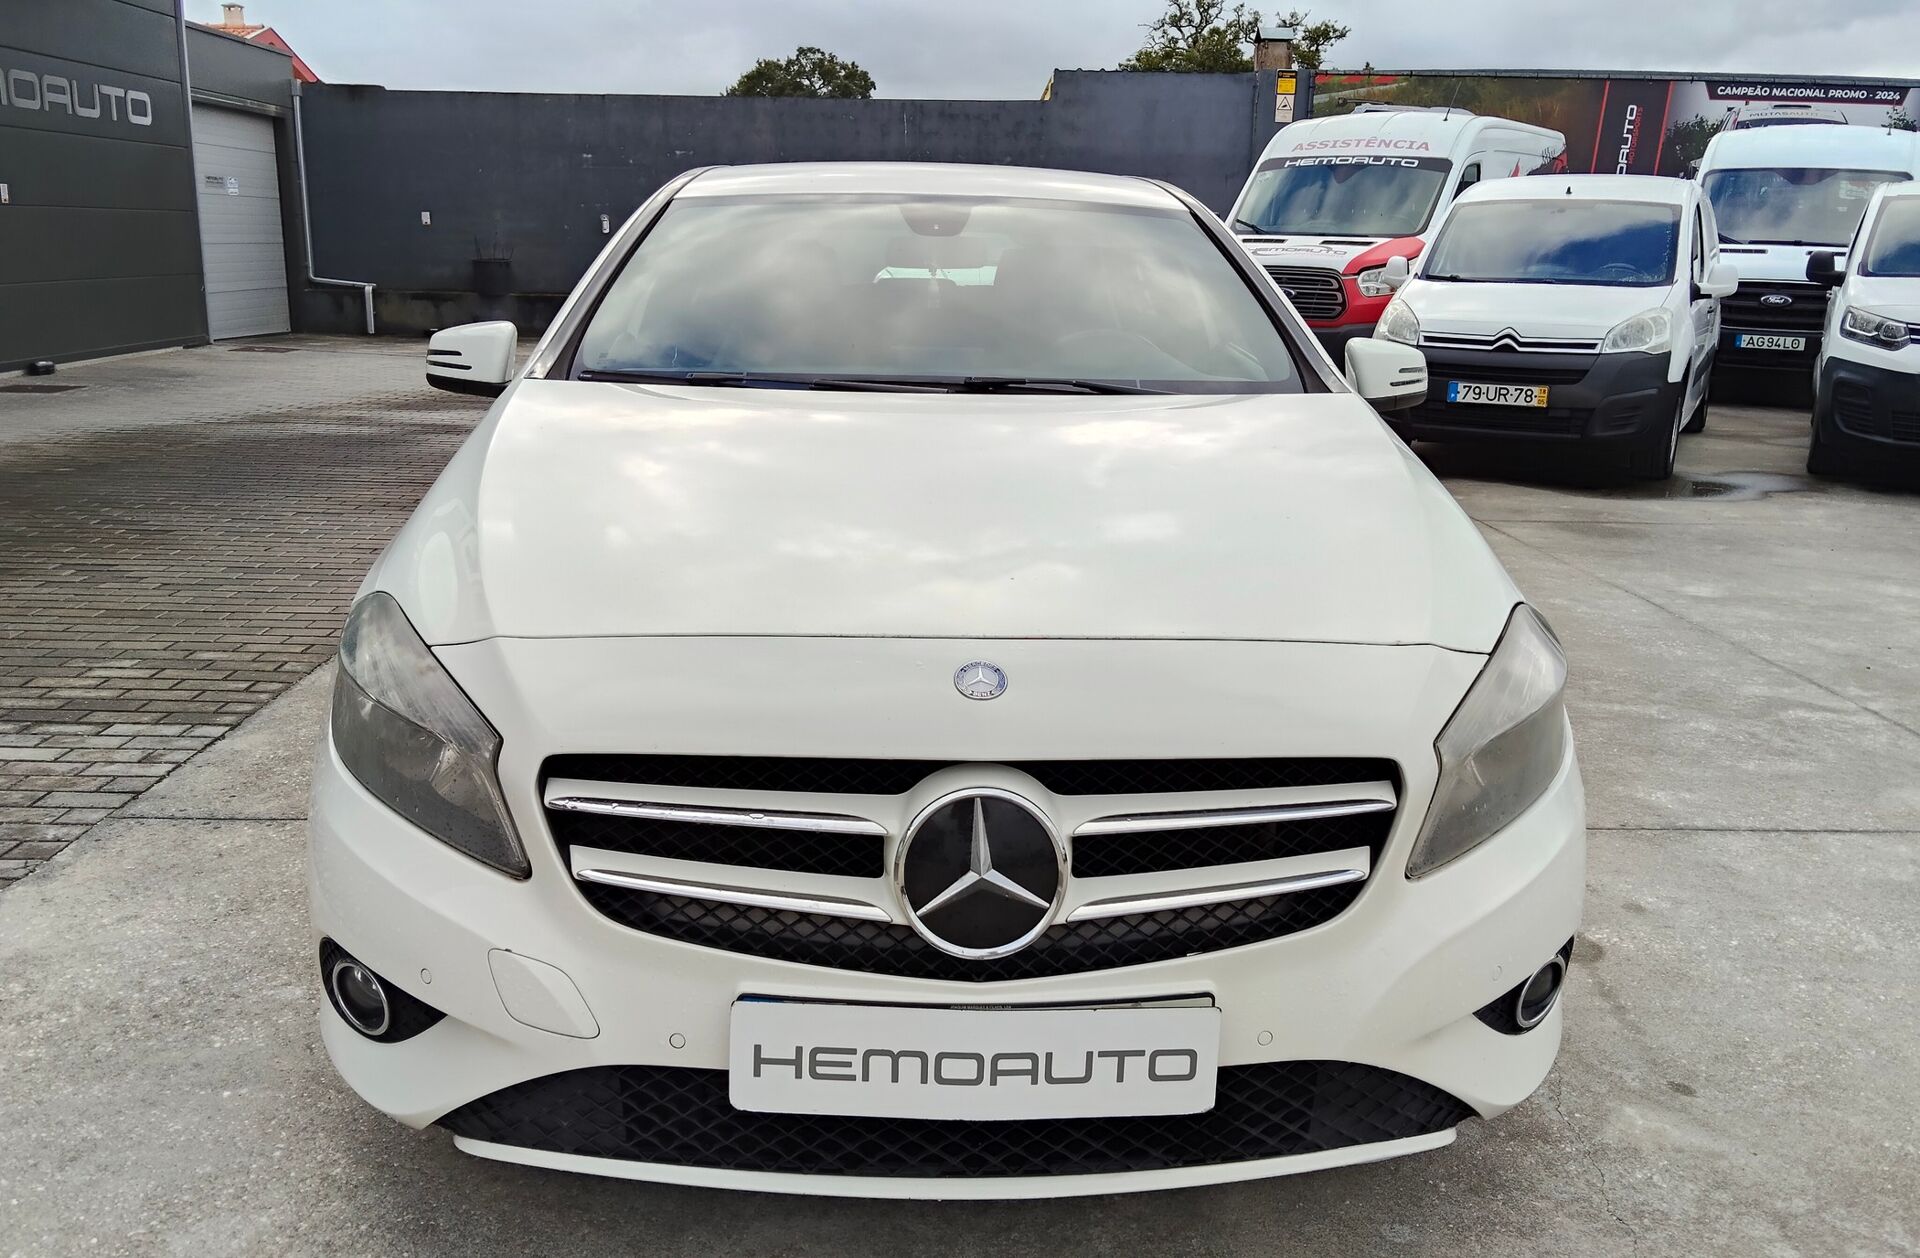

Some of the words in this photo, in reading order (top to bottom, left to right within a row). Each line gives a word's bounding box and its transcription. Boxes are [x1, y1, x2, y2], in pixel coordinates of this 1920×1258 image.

[0, 67, 152, 126] OAUTO
[1717, 85, 1770, 97] CAMPEÃO
[1772, 87, 1826, 98] NACIONAL
[1828, 90, 1867, 99] PROMO
[1875, 91, 1901, 100] 2024
[1291, 137, 1430, 152] ASSISTÊNCIA
[1284, 156, 1419, 168] HEMOAUTO
[752, 1043, 1198, 1086] HEMOAUTO
